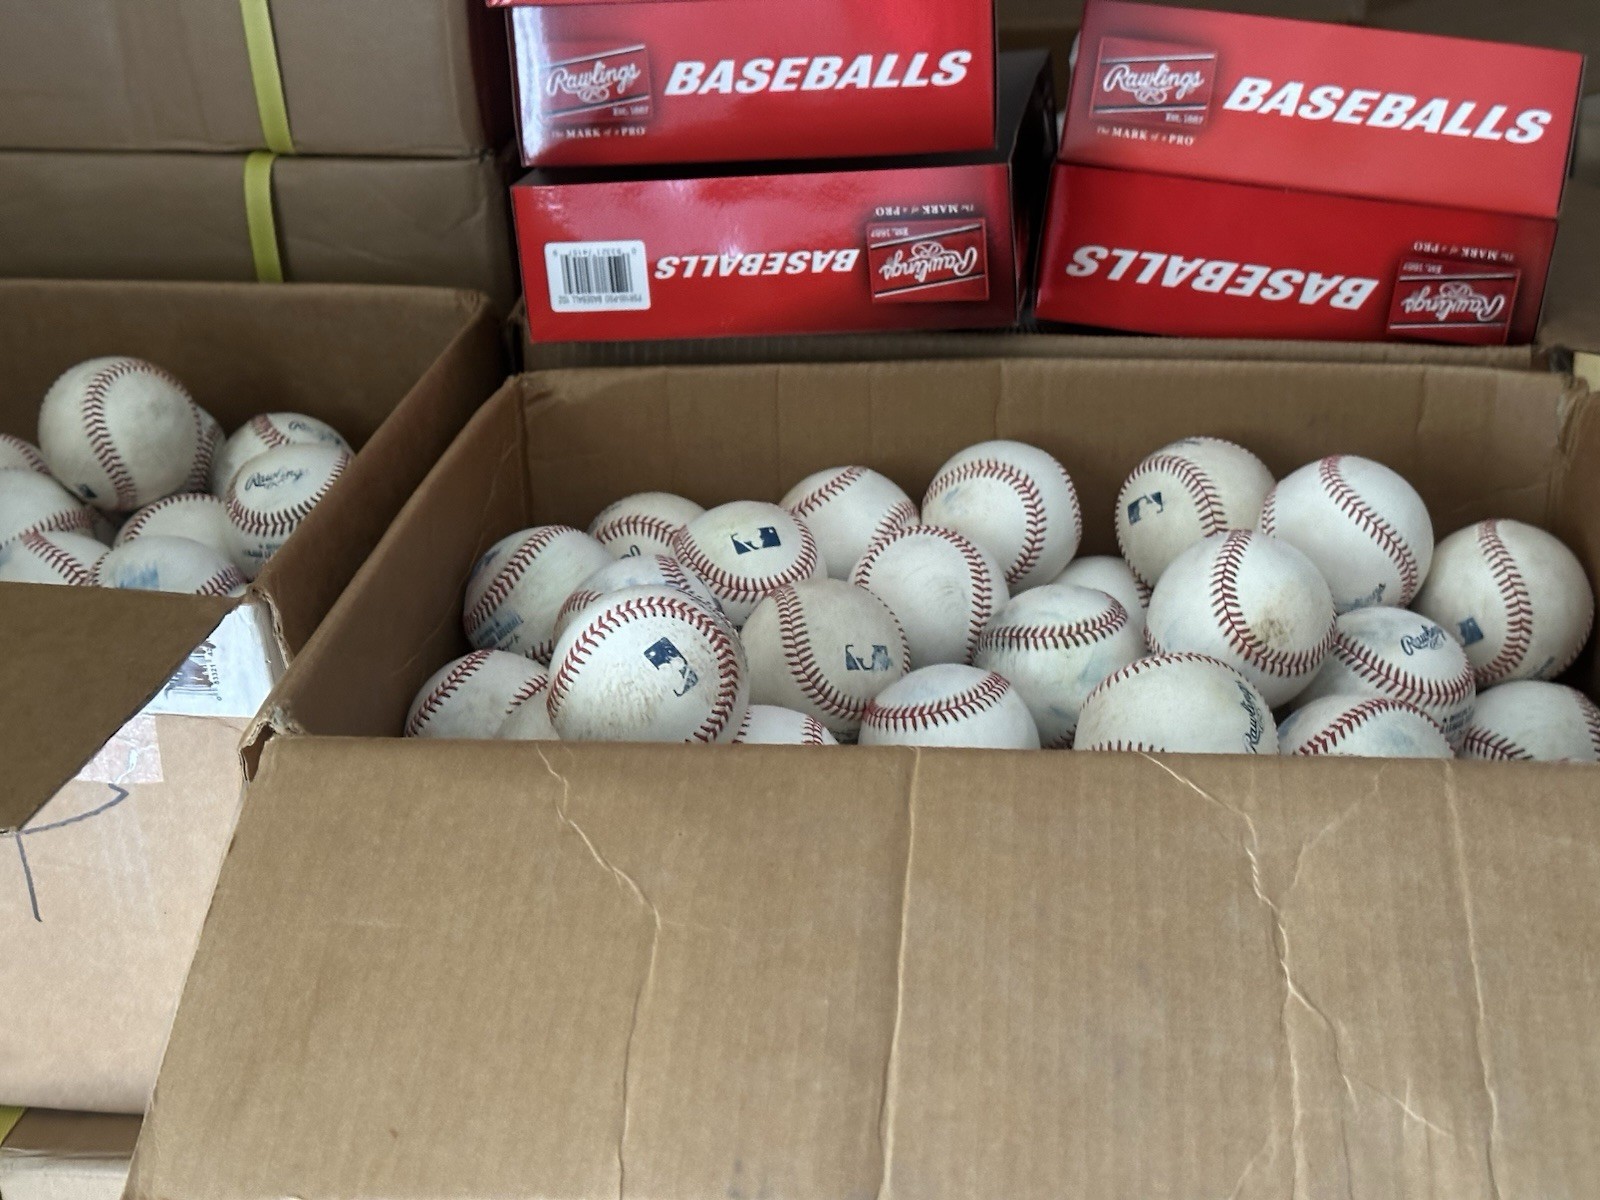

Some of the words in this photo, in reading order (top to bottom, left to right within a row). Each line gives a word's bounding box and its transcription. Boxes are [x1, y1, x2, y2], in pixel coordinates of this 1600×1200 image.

[546, 60, 641, 103] Rawlings
[664, 50, 972, 96] BASEBALLS
[1103, 62, 1205, 105] Rawlings
[1222, 76, 1552, 144] BASEBALLS
[566, 128, 600, 138] MARK
[621, 126, 646, 136] PRO
[1112, 127, 1147, 141] MARK
[1169, 134, 1194, 146] PRO
[875, 206, 900, 216] PRO
[922, 204, 958, 215] MARK
[654, 249, 860, 280] BASEBALLS
[879, 241, 978, 283] Rawlings
[1413, 241, 1440, 254] PRO
[1461, 246, 1499, 260] MARK
[1065, 245, 1380, 311] BASEBALLS
[1401, 281, 1505, 322] Rawlings
